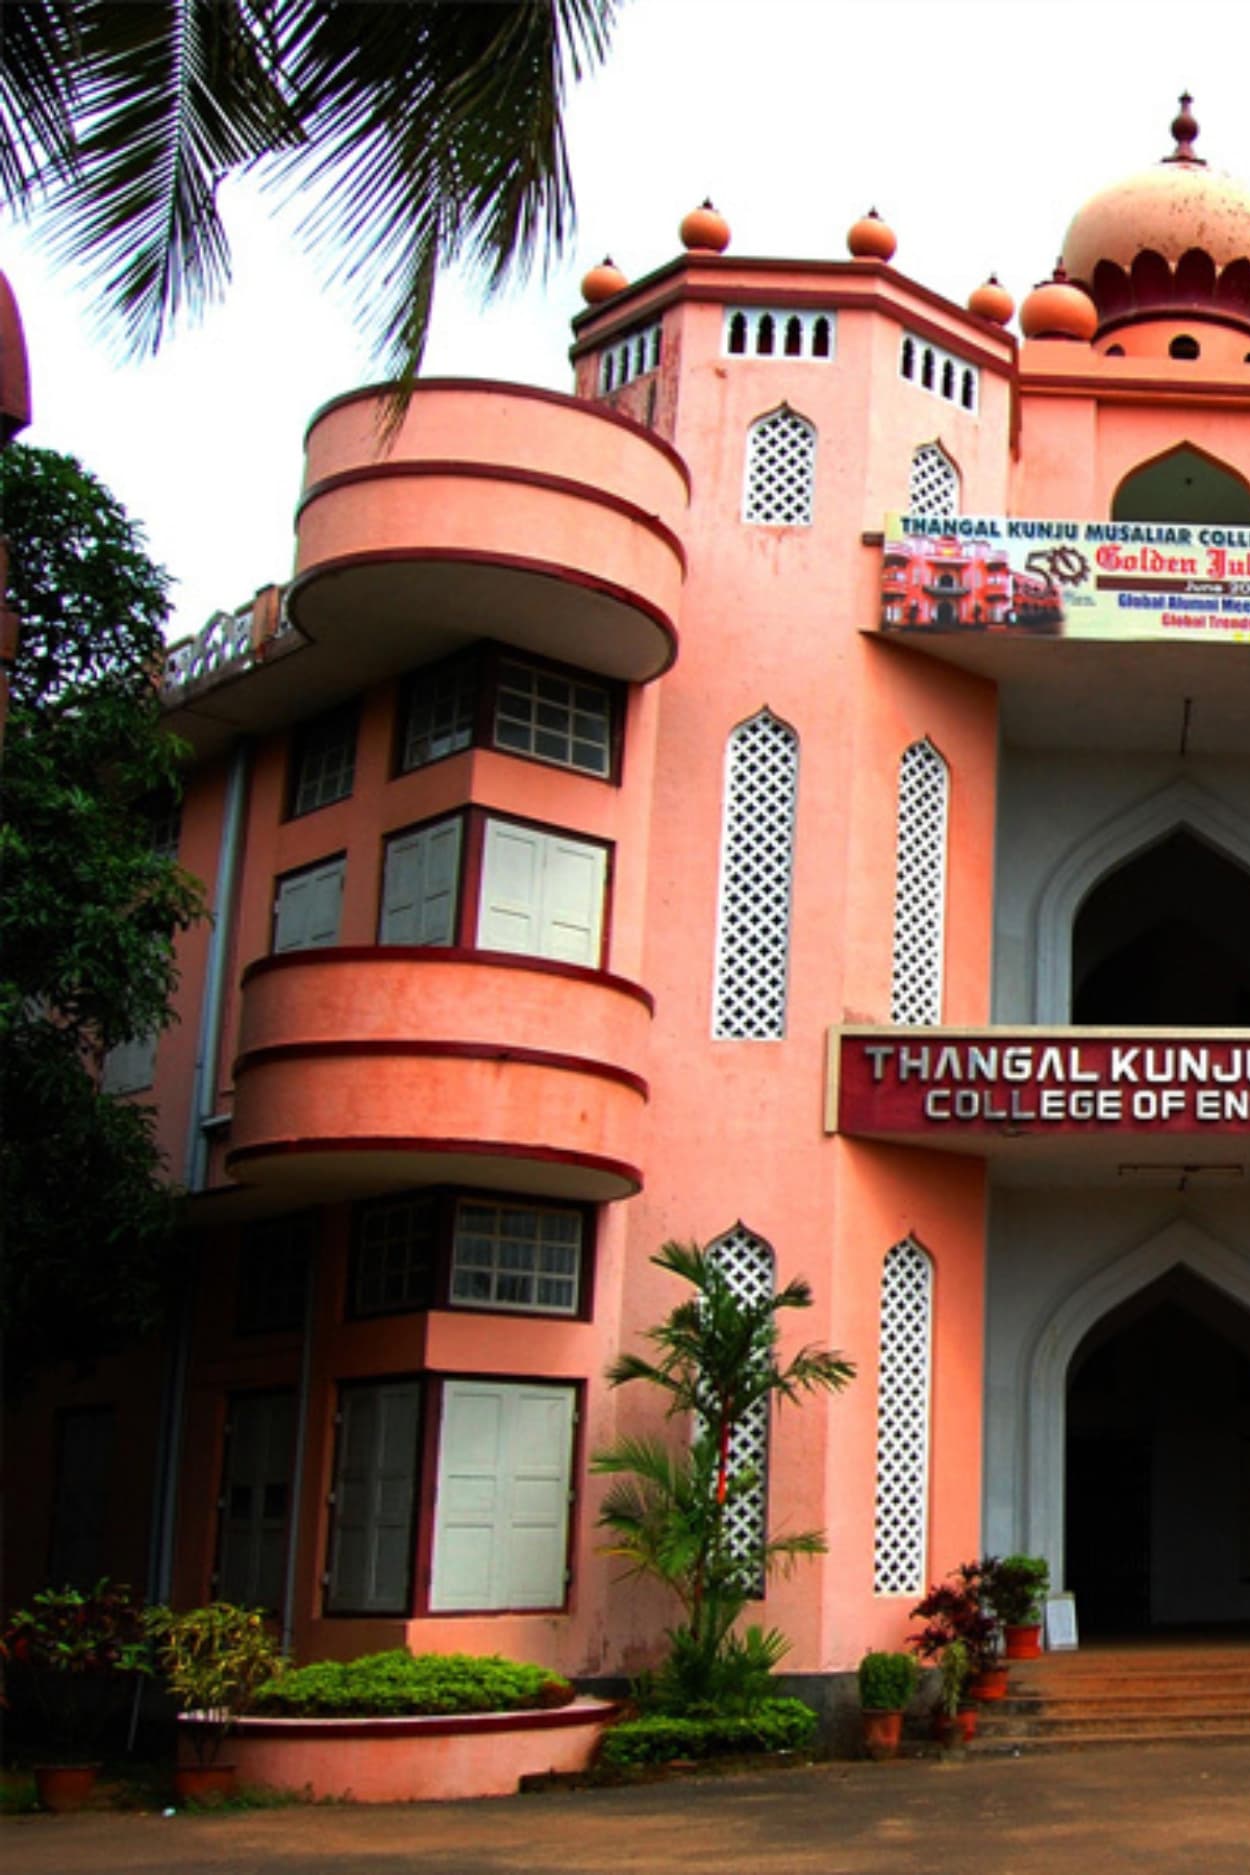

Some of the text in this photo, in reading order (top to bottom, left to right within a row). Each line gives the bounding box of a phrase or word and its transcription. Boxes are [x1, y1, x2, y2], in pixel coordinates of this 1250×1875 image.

[901, 517, 1000, 538] THANGAL
[1007, 521, 1078, 540] KUNJU
[1085, 524, 1191, 545] MUSALIAR
[1095, 543, 1197, 574] Golden
[865, 1046, 1099, 1082] THANGAL
[925, 1089, 1122, 1120] COLLEGE
[1132, 1089, 1186, 1120] OF
